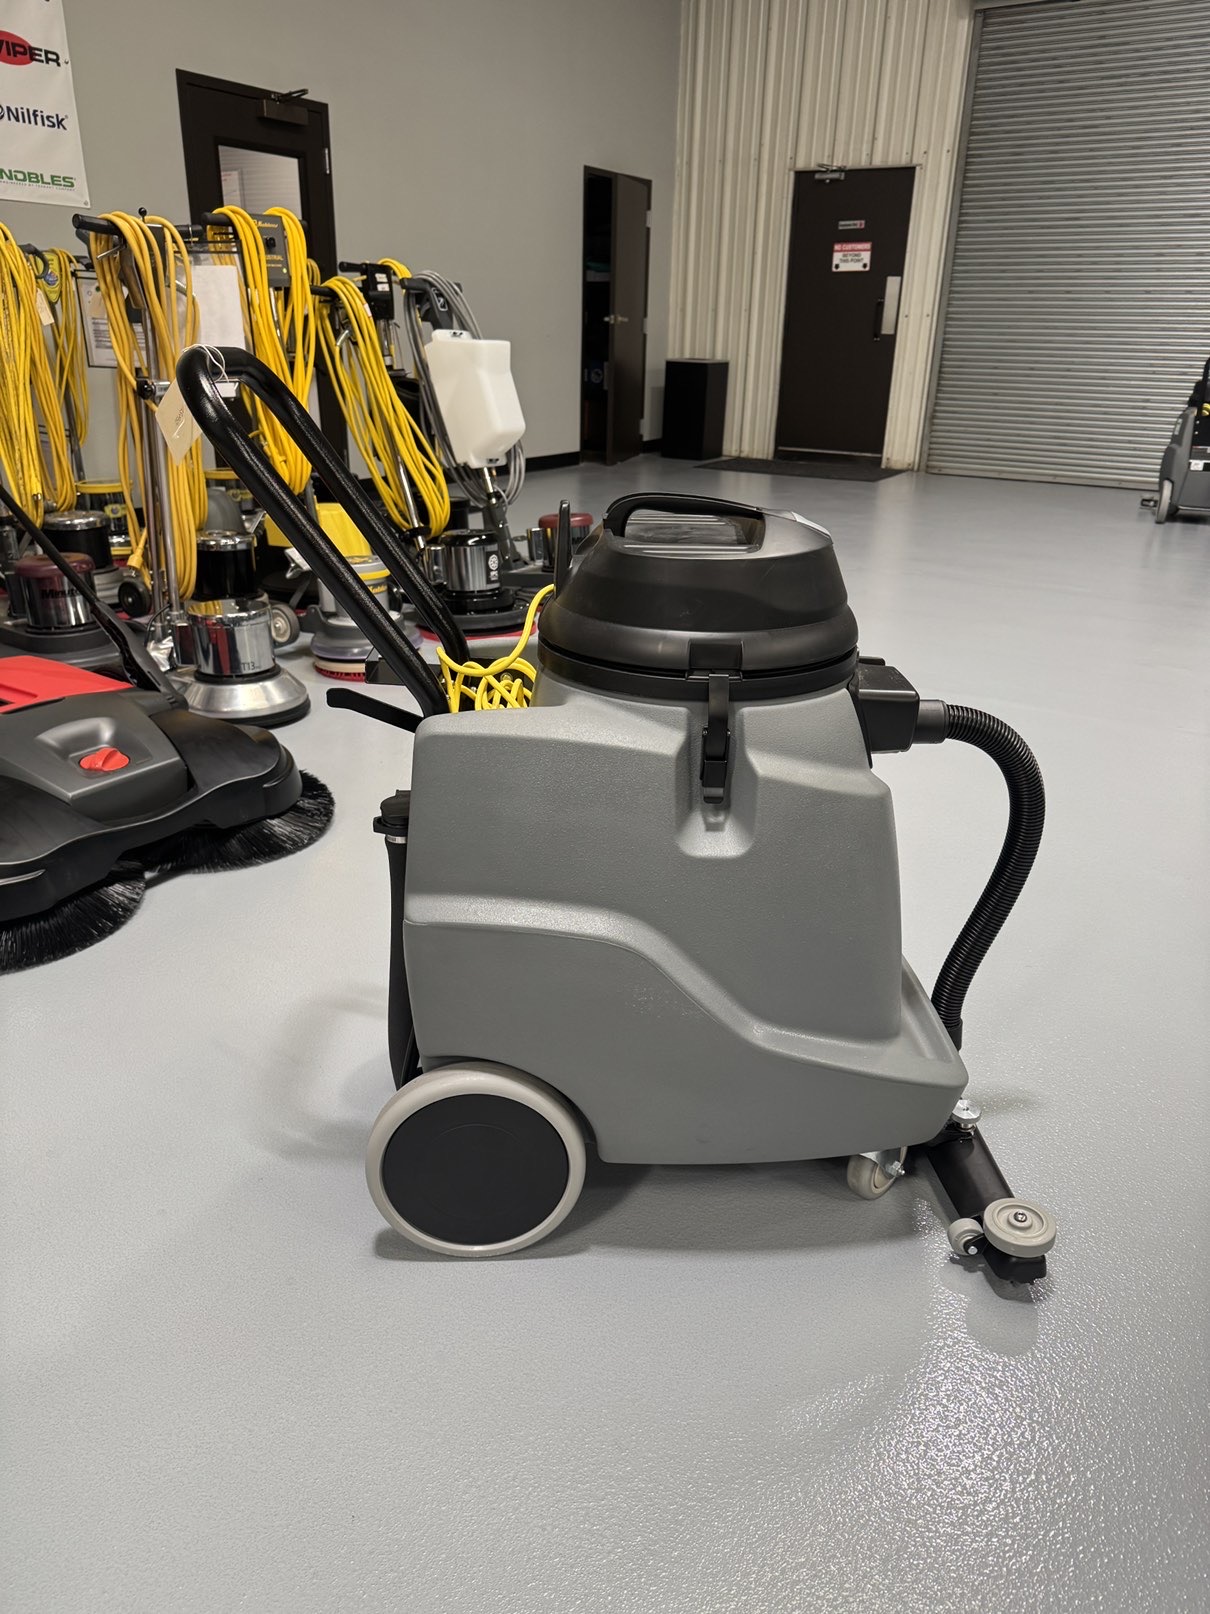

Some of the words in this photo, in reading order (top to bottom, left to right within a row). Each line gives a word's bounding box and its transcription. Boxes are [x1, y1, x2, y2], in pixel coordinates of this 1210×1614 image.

[6, 105, 68, 131] Nilfisk
[0, 168, 75, 188] NOBLES
[241, 661, 256, 671] T13
